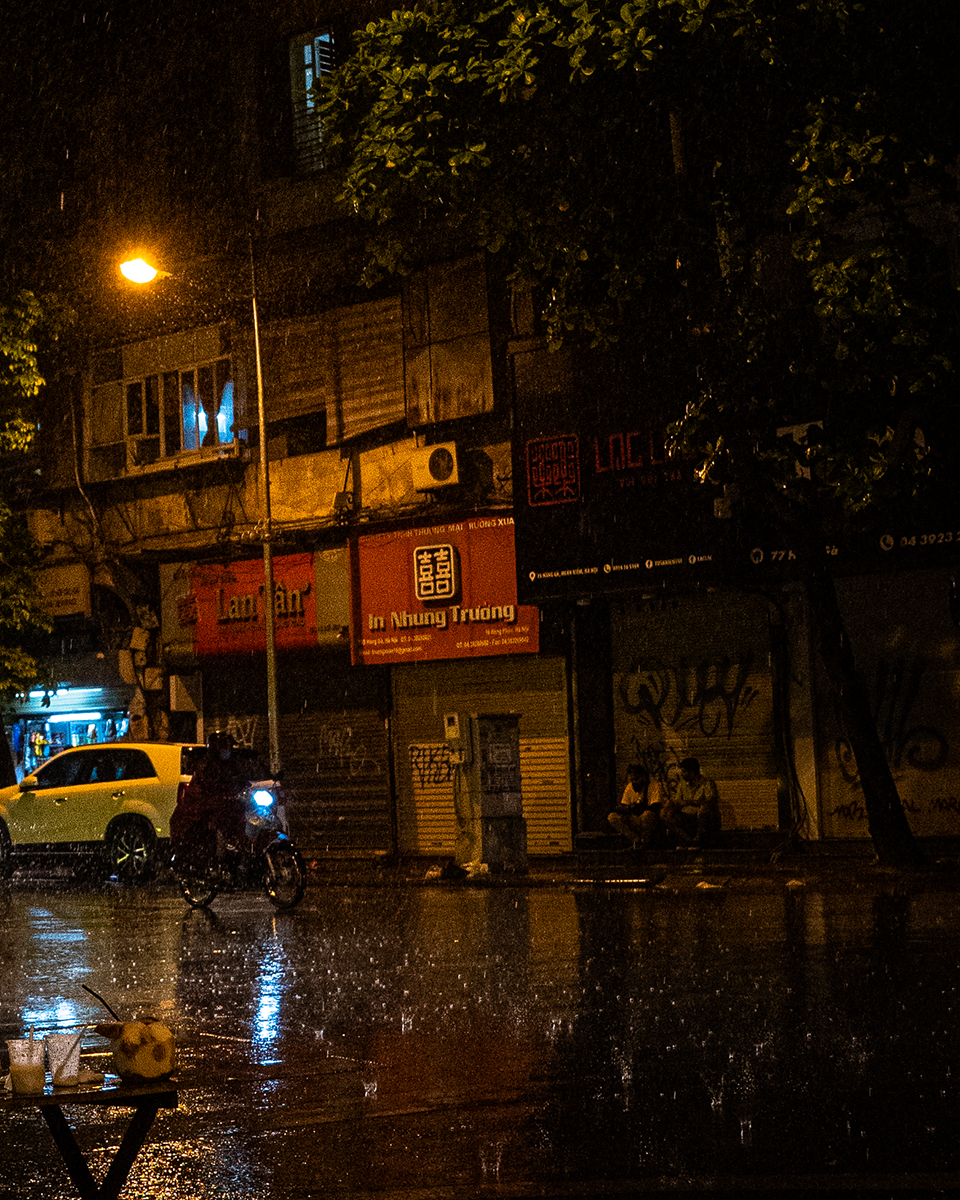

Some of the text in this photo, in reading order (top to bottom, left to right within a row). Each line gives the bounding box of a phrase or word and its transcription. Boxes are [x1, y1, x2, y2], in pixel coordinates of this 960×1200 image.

[919, 531, 953, 547] 3923
[770, 550, 786, 561] 77
[368, 613, 386, 630] In
[391, 609, 447, 630] Nhung
